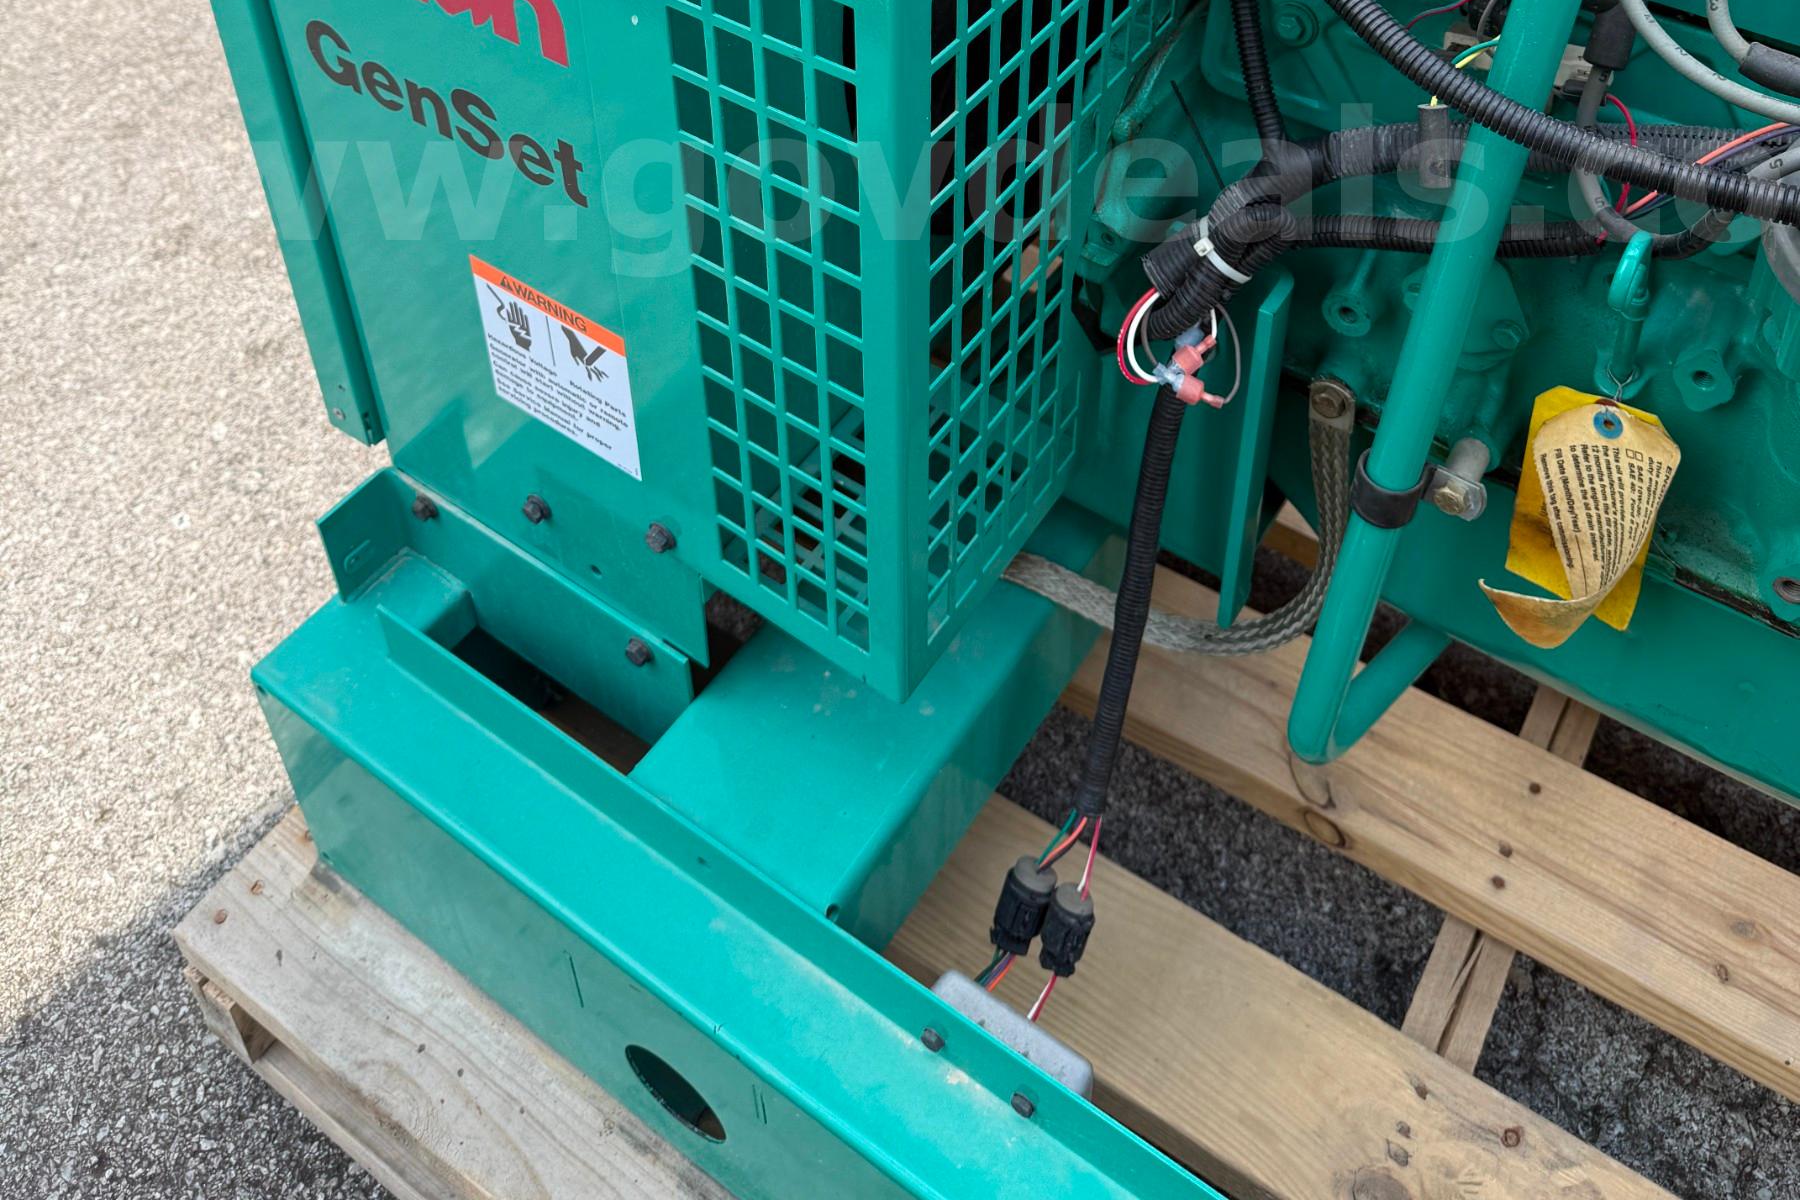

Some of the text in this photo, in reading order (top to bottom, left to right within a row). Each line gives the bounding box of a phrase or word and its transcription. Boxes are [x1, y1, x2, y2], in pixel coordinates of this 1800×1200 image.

[306, 19, 589, 208] GenSet
[513, 282, 586, 331] WARNING
[1581, 444, 1590, 463] Refer
[1592, 445, 1599, 453] 12
[1612, 448, 1620, 463] This
[1585, 464, 1592, 472] to
[1594, 455, 1604, 482] months
[1628, 462, 1636, 480] SAE
[1540, 453, 1551, 480] Remove
[1546, 480, 1554, 493] this
[1553, 506, 1561, 520] after
[1554, 448, 1581, 533] Fill Date (Month/Day/Year)
[1572, 454, 1585, 488] determine
[1586, 512, 1594, 531] drain
[1591, 486, 1600, 511] engine
[1600, 484, 1608, 501] from
[1605, 459, 1618, 516] manufacturer's
